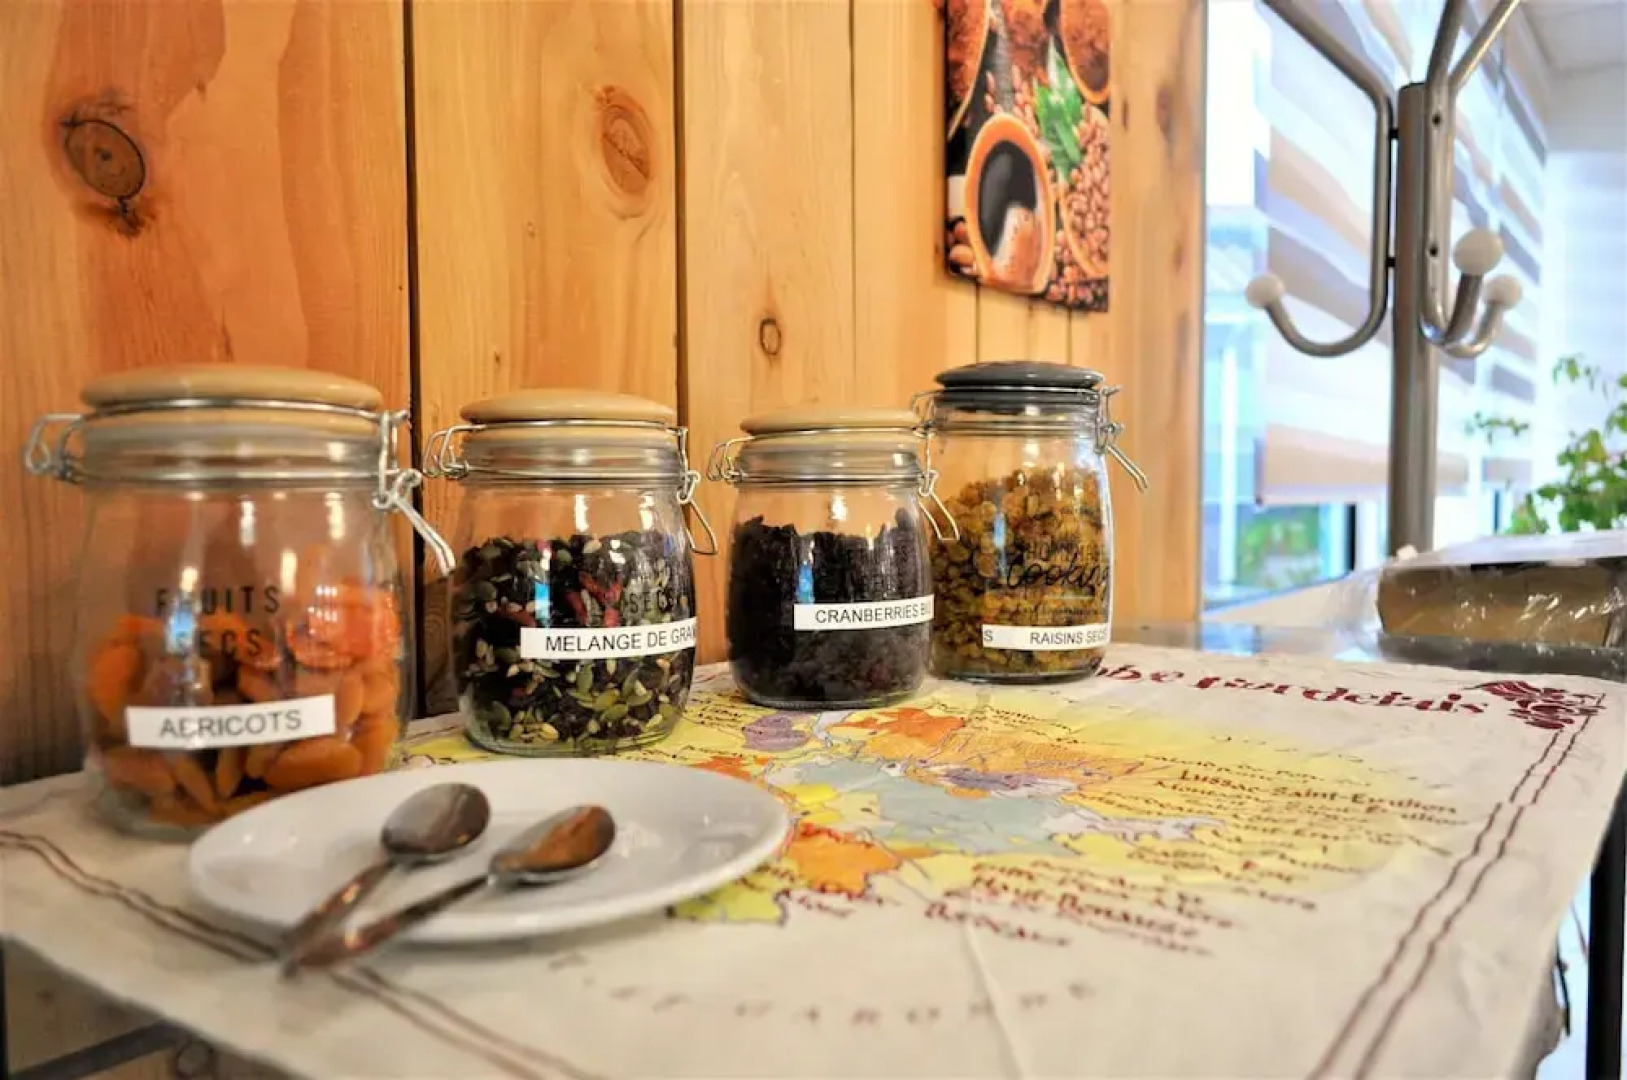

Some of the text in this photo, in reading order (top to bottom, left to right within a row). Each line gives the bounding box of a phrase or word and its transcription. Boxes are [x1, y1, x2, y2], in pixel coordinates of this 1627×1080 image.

[156, 585, 281, 614] FUITS
[815, 603, 918, 624] CRANBERRIES
[178, 628, 262, 658] ECS
[545, 631, 642, 653] MELANGE
[647, 630, 667, 648] DE
[983, 629, 994, 642] S
[1029, 631, 1084, 645] RAISINS
